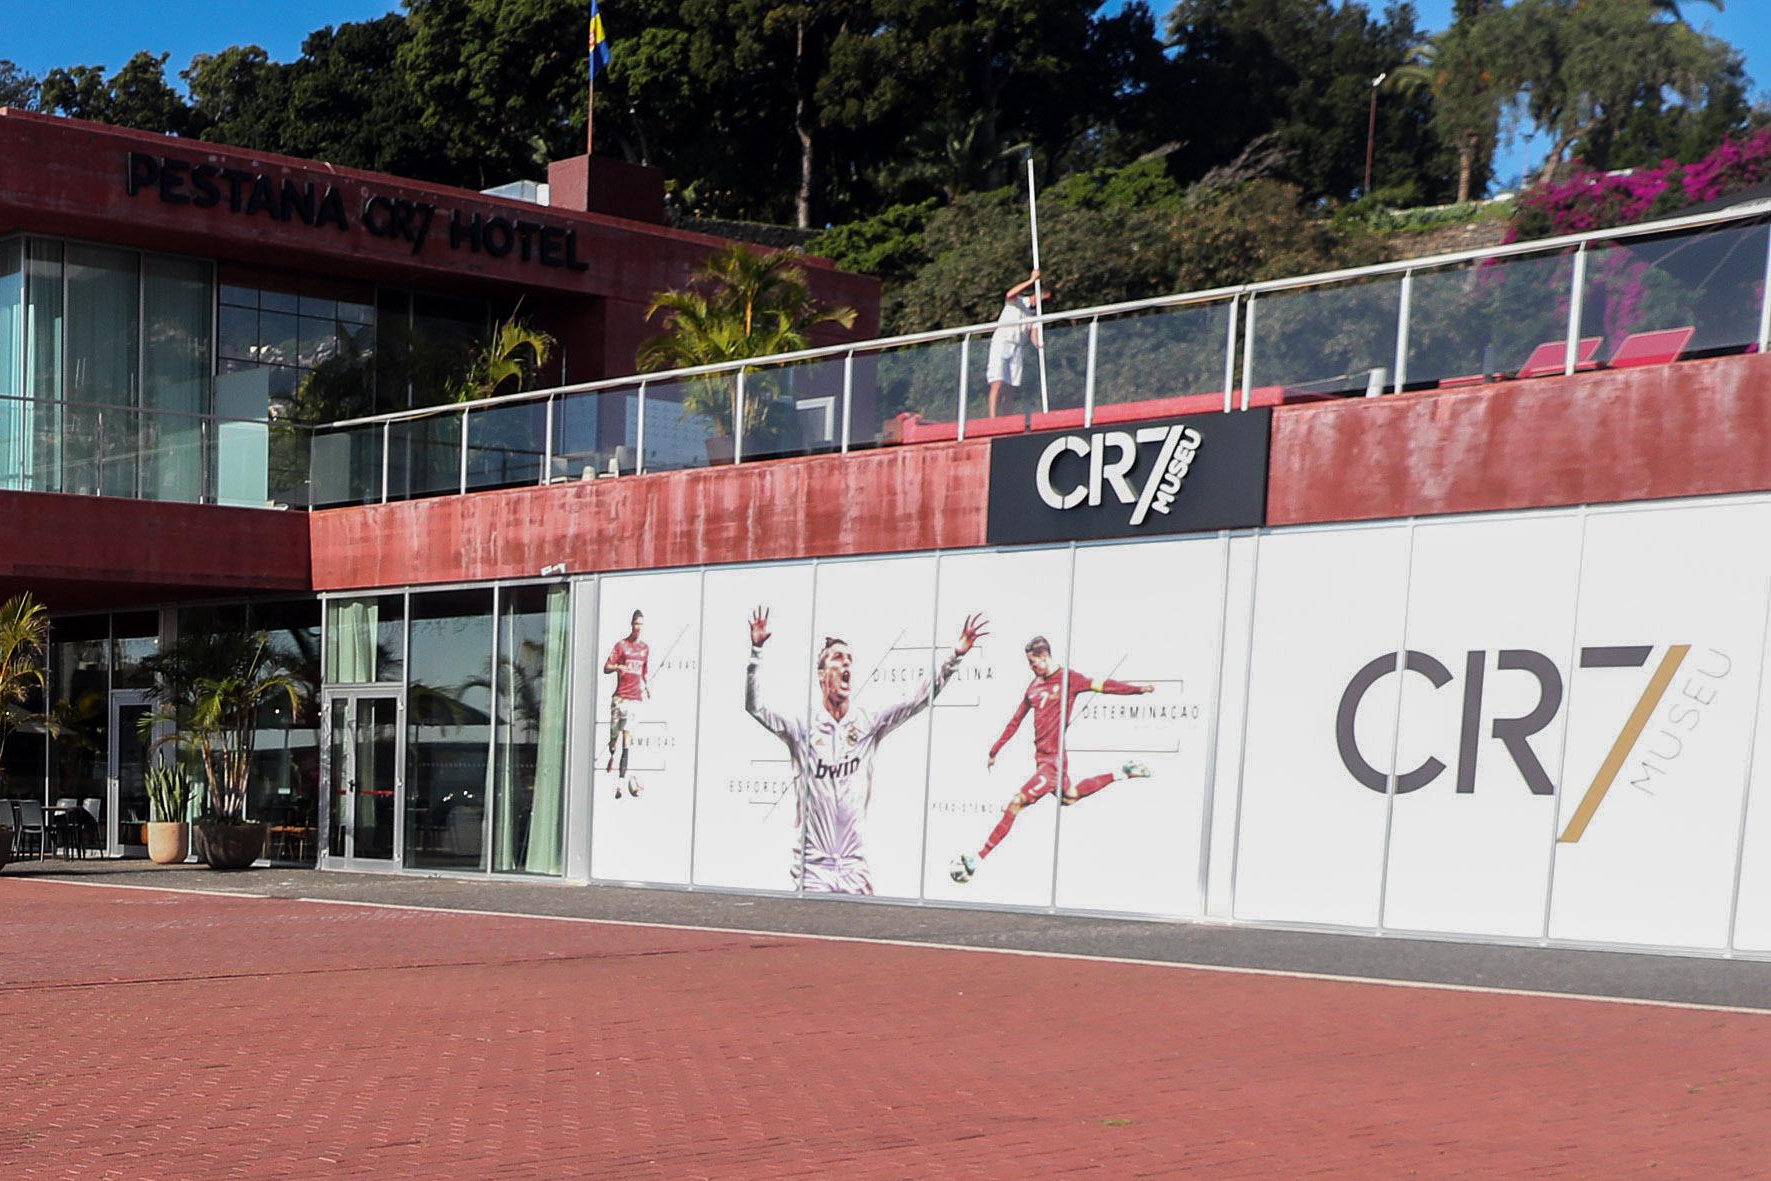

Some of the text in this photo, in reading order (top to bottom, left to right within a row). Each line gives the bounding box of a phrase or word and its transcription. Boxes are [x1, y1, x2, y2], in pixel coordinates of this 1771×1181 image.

[127, 151, 589, 271] PESTANA CR7 HOTEL
[1035, 424, 1185, 527] CR7
[1151, 428, 1202, 515] MUSEU
[815, 754, 861, 780] bwin
[1336, 644, 1692, 843] CR7
[1630, 646, 1733, 796] MUSEU
